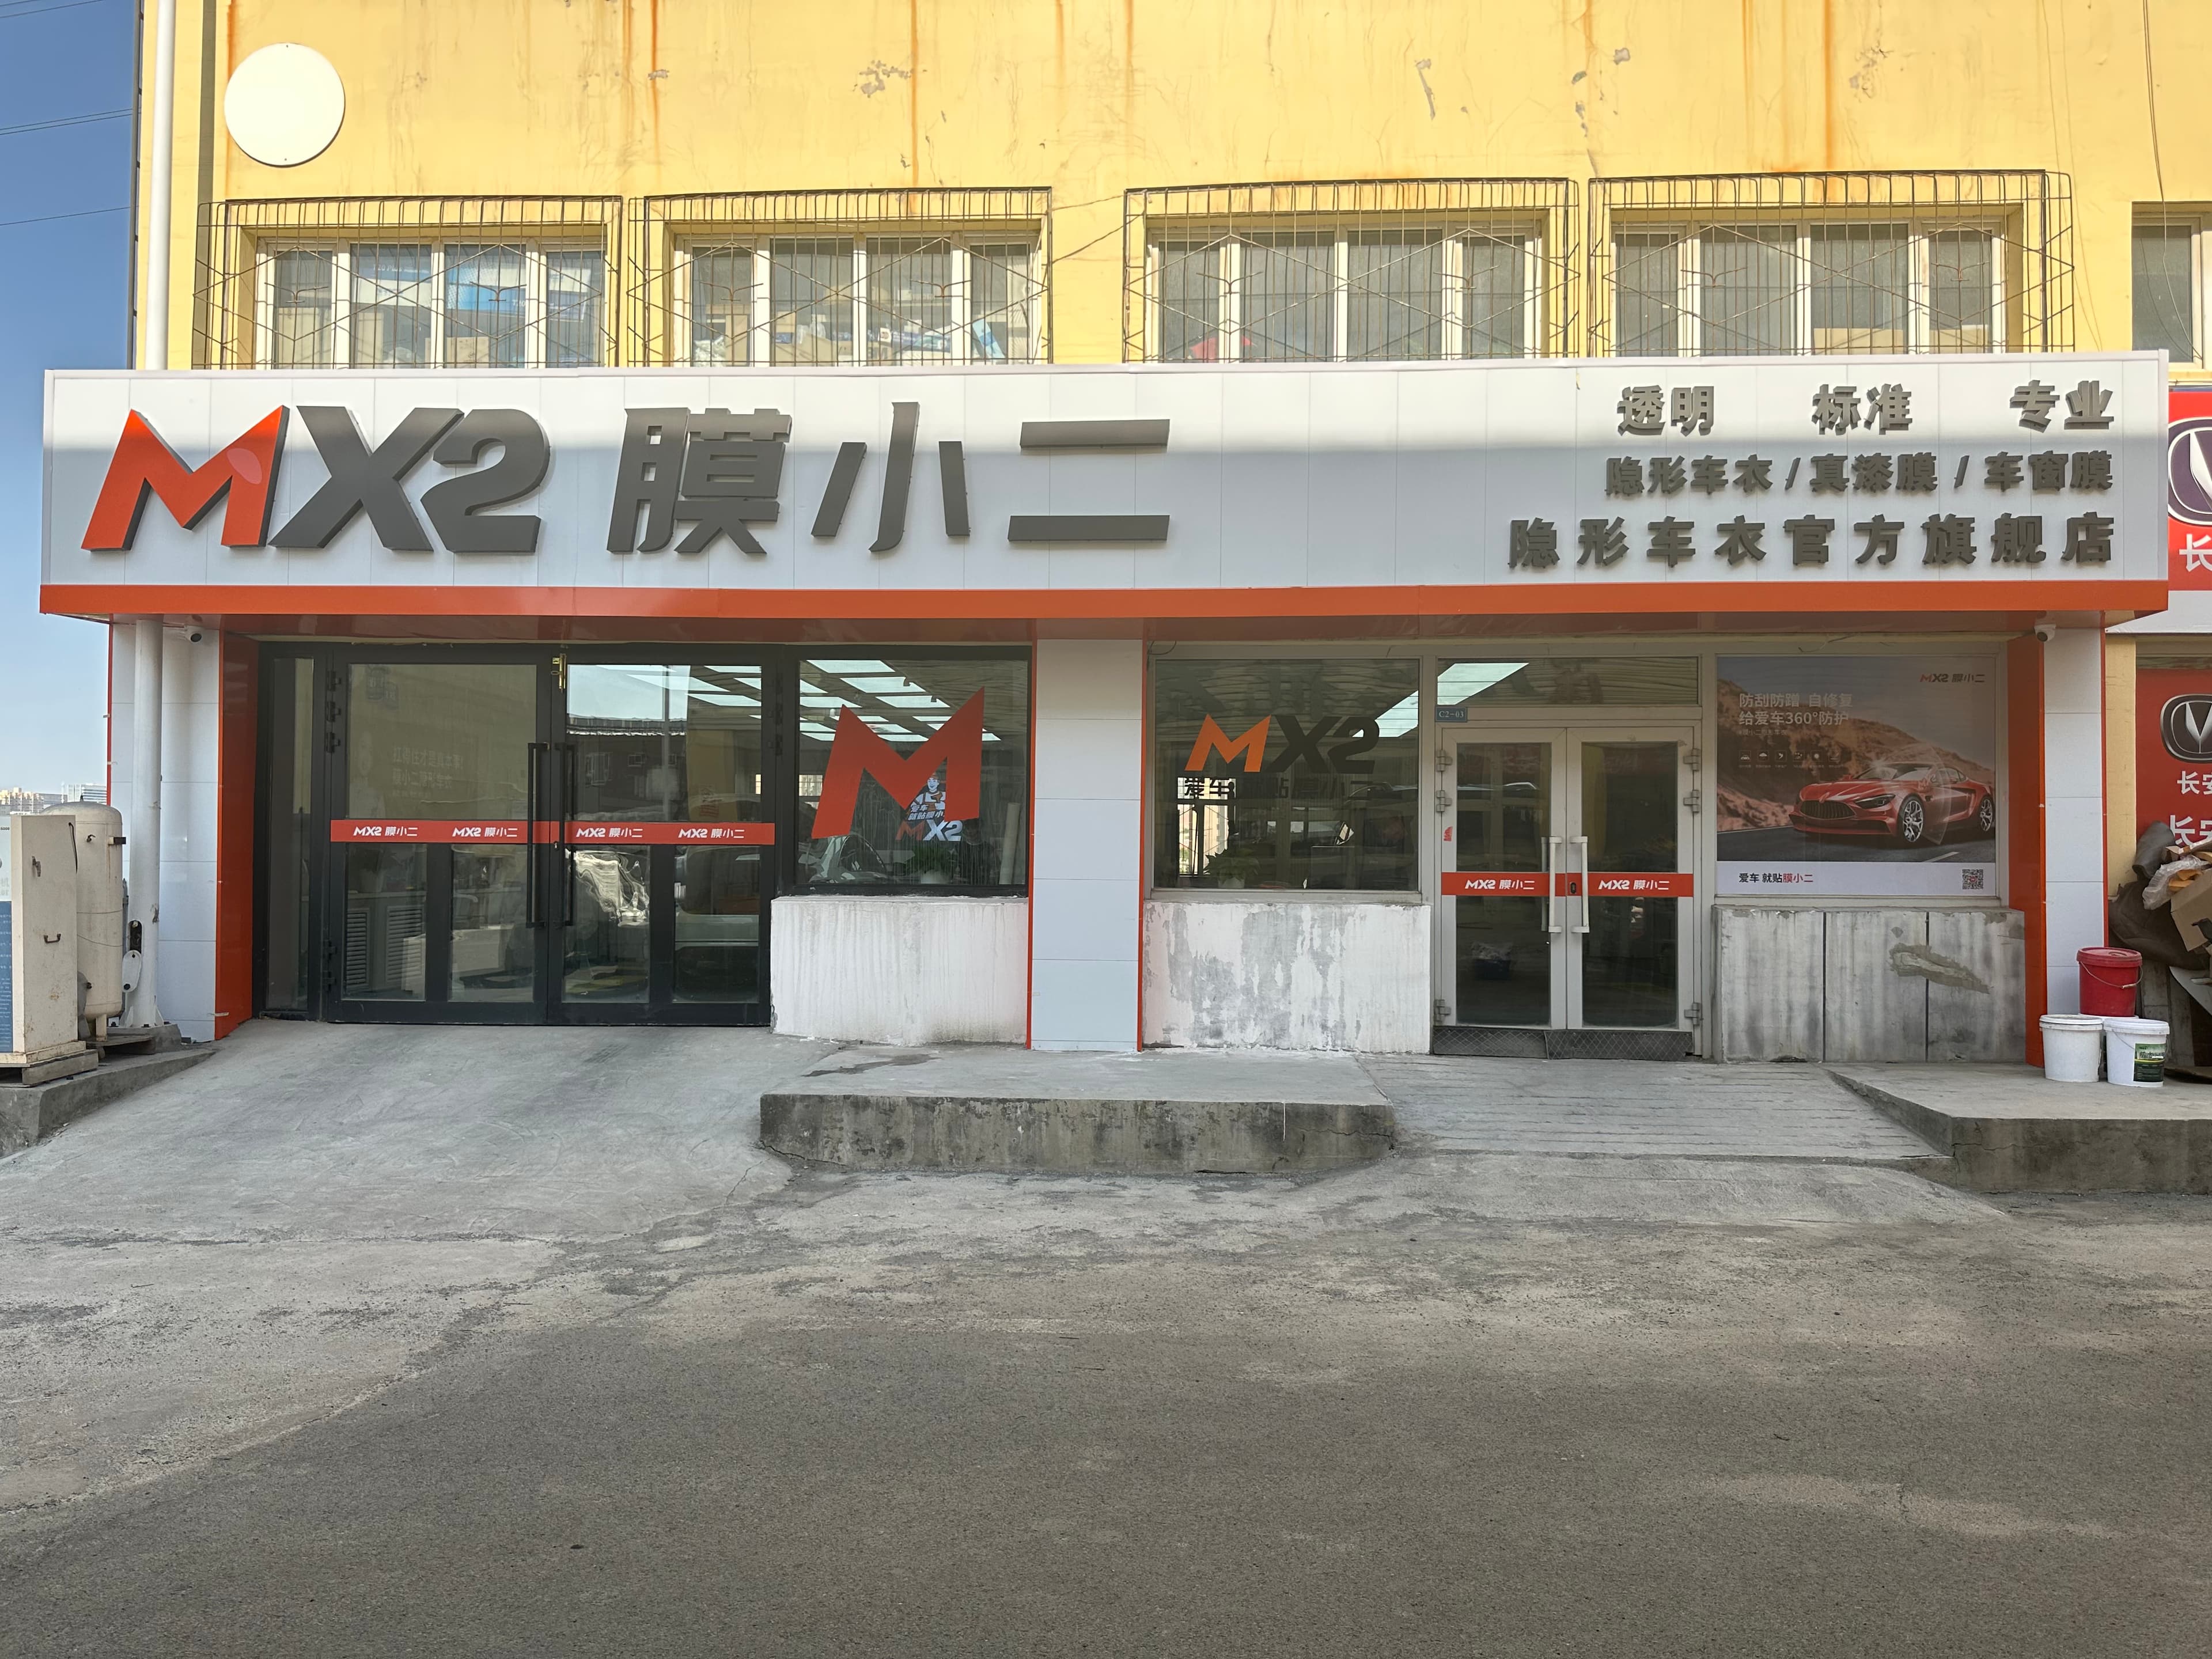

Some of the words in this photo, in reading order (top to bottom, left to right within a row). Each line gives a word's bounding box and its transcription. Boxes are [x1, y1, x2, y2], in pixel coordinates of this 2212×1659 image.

[1616, 385, 1715, 437] 透明
[1812, 383, 1914, 436] 标准
[2010, 380, 2115, 433] 专业
[81, 404, 551, 554] MX2
[607, 402, 1171, 555] 膜小二
[1509, 513, 2115, 569] 隐形车衣官方旗舰店
[1739, 693, 1800, 708] 防刮防蹭
[1809, 693, 1853, 708] 自修复
[1438, 710, 1464, 719] C2-03
[1738, 710, 1849, 726] 给爱车360°防护
[1184, 713, 1380, 775] MX2
[353, 826, 381, 836] MX2
[385, 826, 418, 836] 膜小二
[452, 827, 482, 837] MX2
[484, 827, 518, 838] 膜小二
[576, 827, 605, 838] MX2
[608, 828, 643, 838] 膜小二
[678, 828, 707, 838] MX2
[711, 828, 745, 839] 膜小二
[895, 819, 963, 842] MX2
[1738, 872, 1760, 884] 爱车
[1762, 872, 1814, 884] 就贴膜小二
[1465, 879, 1495, 890] MX2
[1499, 879, 1535, 890] 膜小二
[1598, 879, 1630, 890] MX2
[1633, 880, 1669, 891] 膜小二
